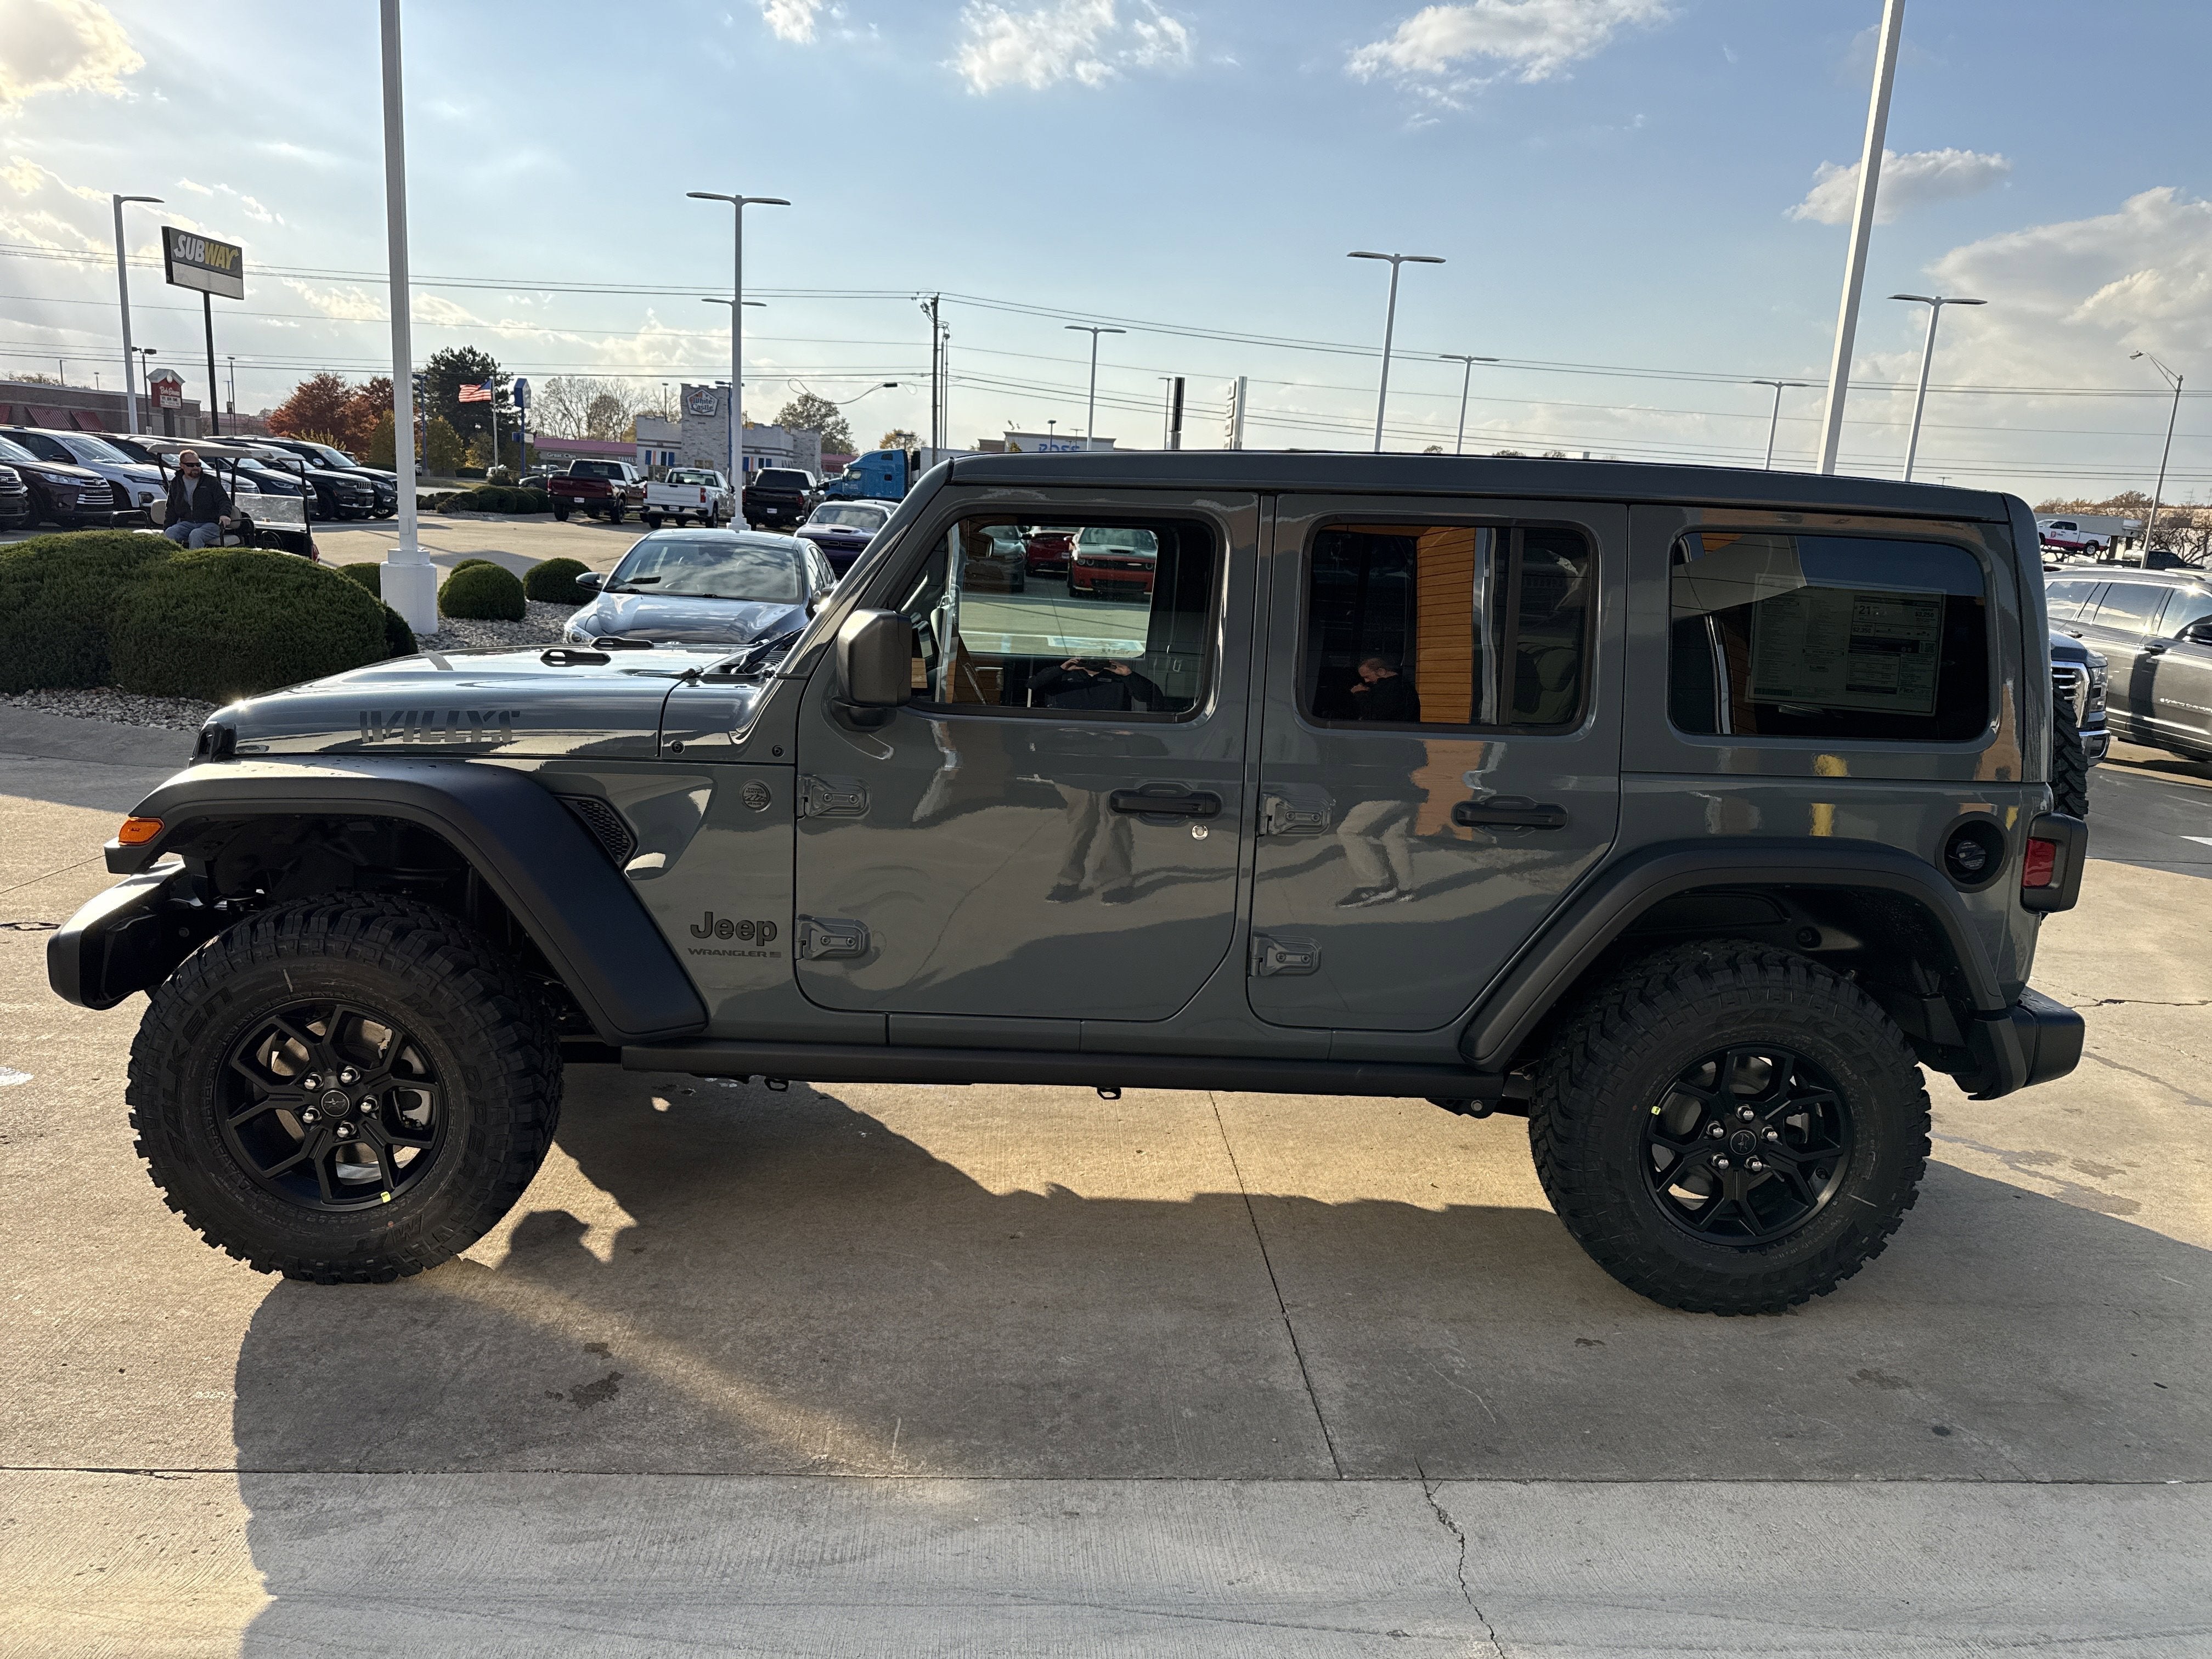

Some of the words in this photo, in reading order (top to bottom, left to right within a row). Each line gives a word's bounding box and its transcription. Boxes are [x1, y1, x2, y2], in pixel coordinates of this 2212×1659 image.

[173, 234, 239, 270] SUBWAY
[1859, 605, 1870, 614] 21
[359, 710, 521, 743] WILLYS
[690, 911, 777, 946] Jeep
[687, 947, 768, 958] WRANGLER
